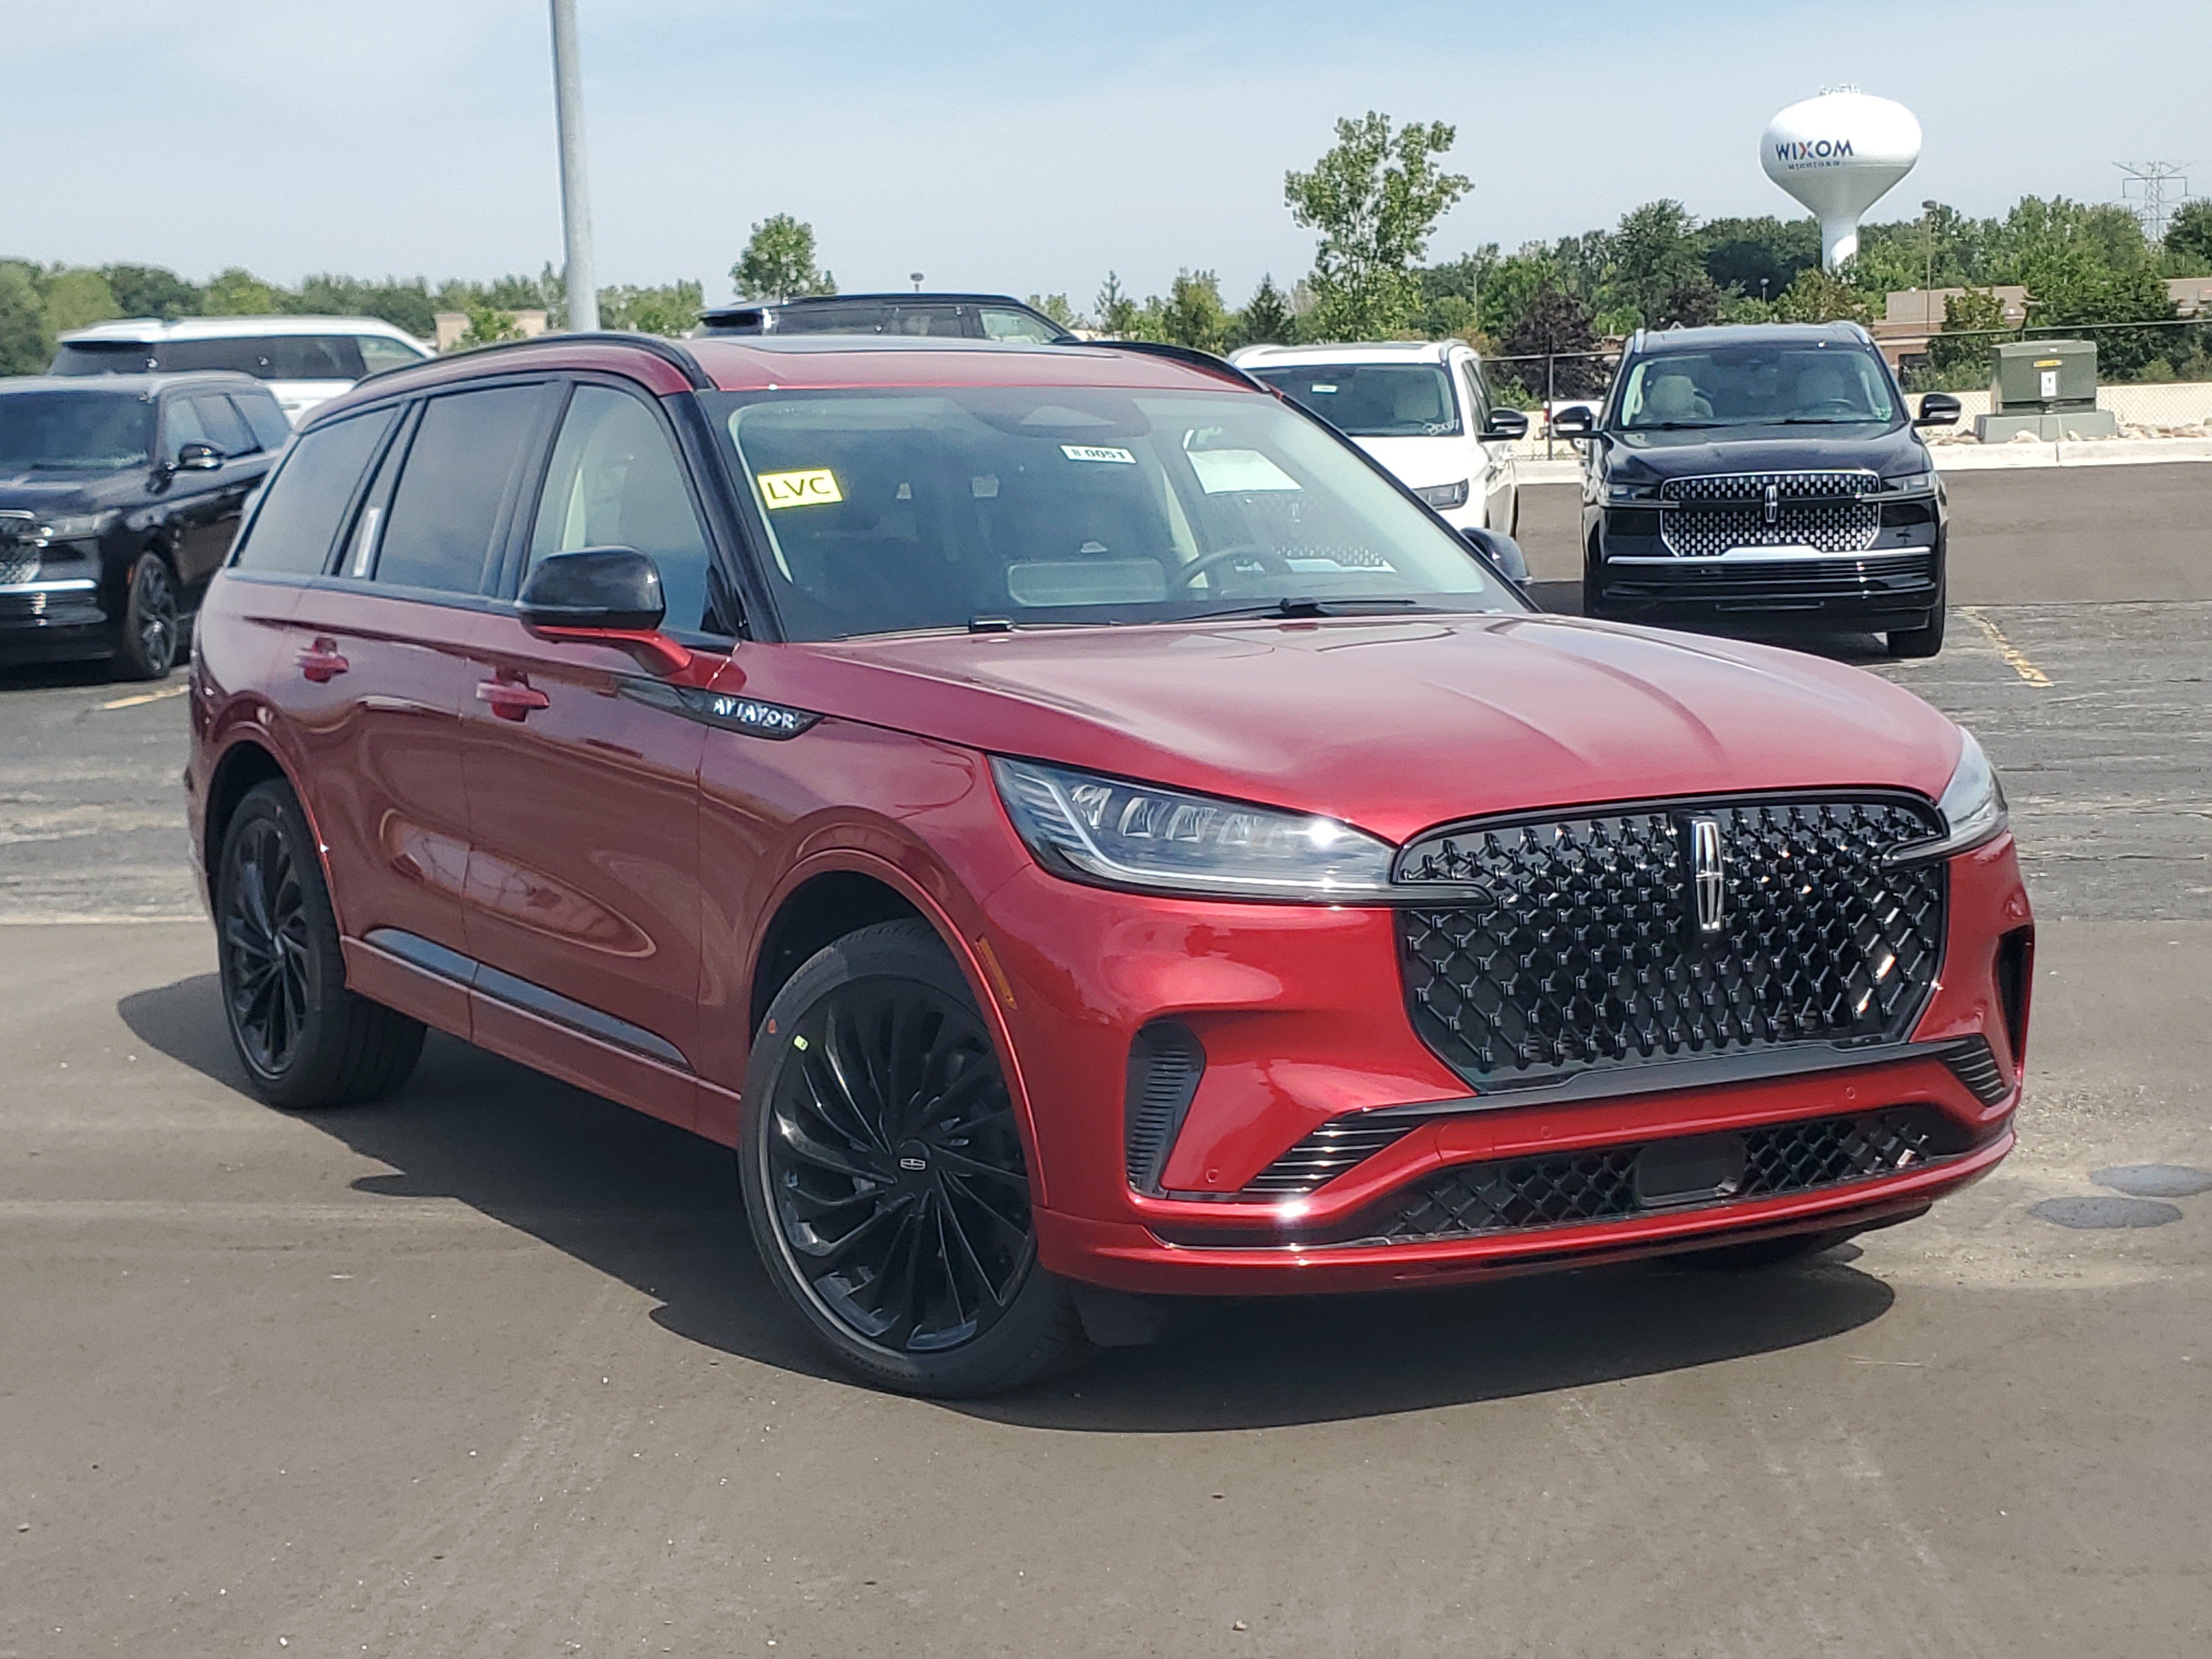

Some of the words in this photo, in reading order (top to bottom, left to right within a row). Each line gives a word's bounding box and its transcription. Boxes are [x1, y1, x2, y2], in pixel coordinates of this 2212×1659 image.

[1775, 139, 1854, 161] WIXOM
[768, 477, 831, 500] LVC
[714, 698, 795, 729] AVIATOR
